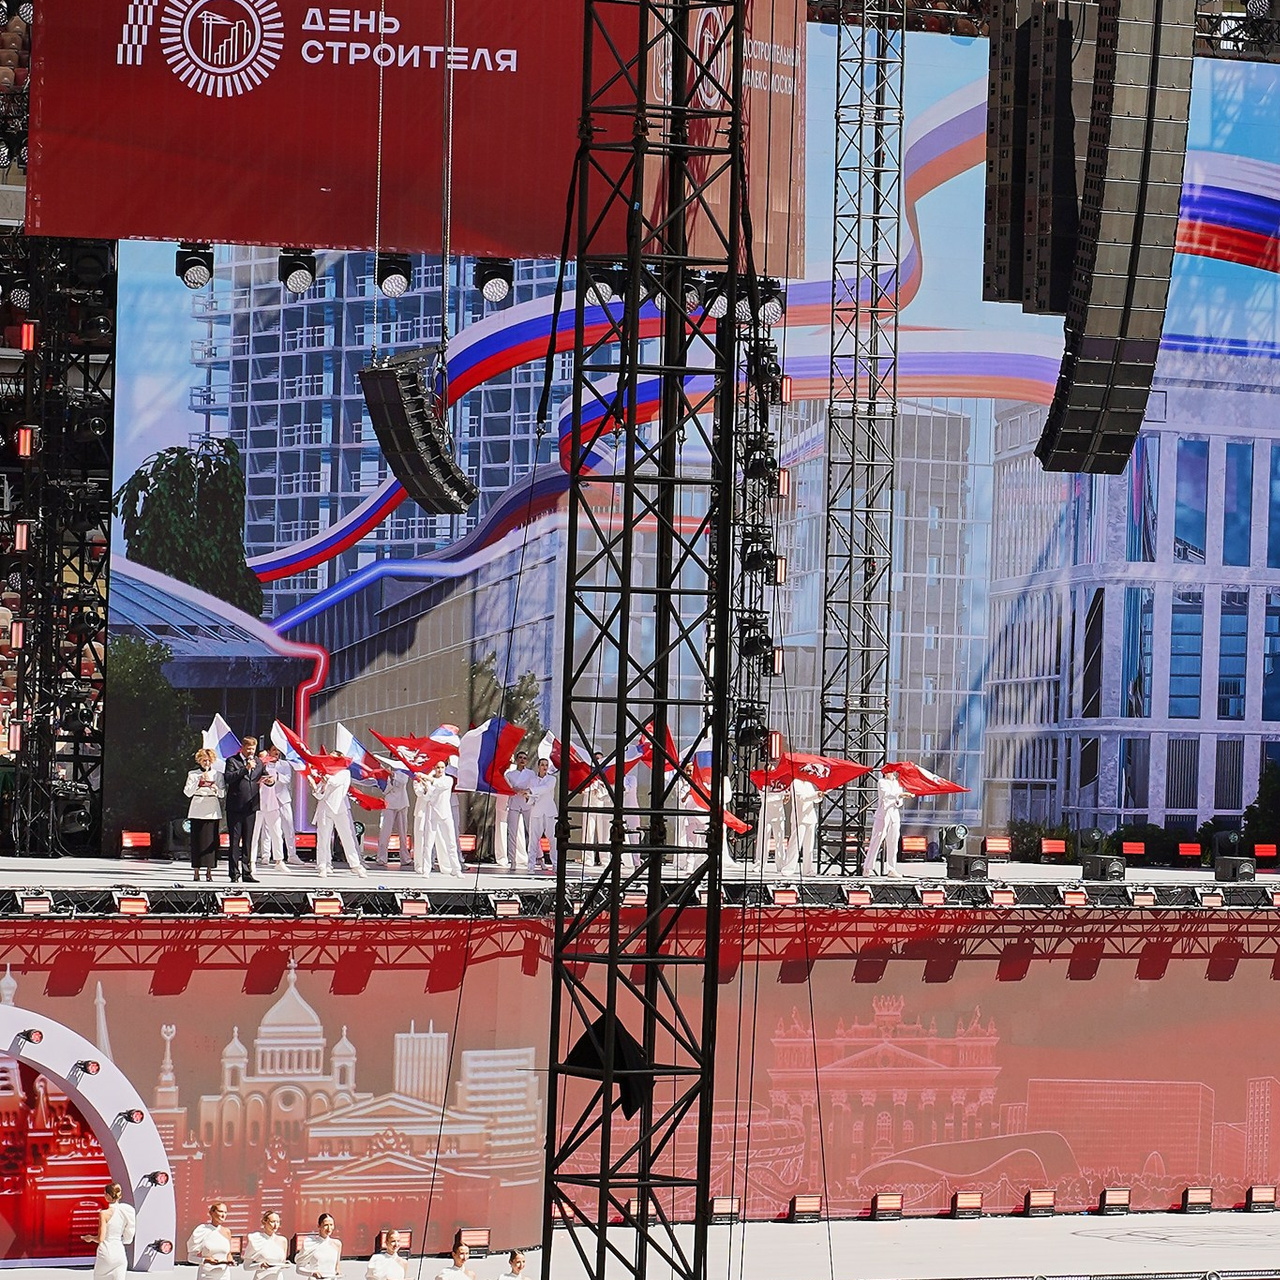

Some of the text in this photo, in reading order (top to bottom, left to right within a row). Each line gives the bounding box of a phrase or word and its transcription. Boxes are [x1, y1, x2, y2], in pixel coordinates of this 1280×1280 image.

[301, 7, 400, 34] ДЕНЬ
[301, 39, 518, 72] СТРОИТЕЛЯ
[743, 37, 800, 67] ДОСТРОИТЕЛЬНЫЙ
